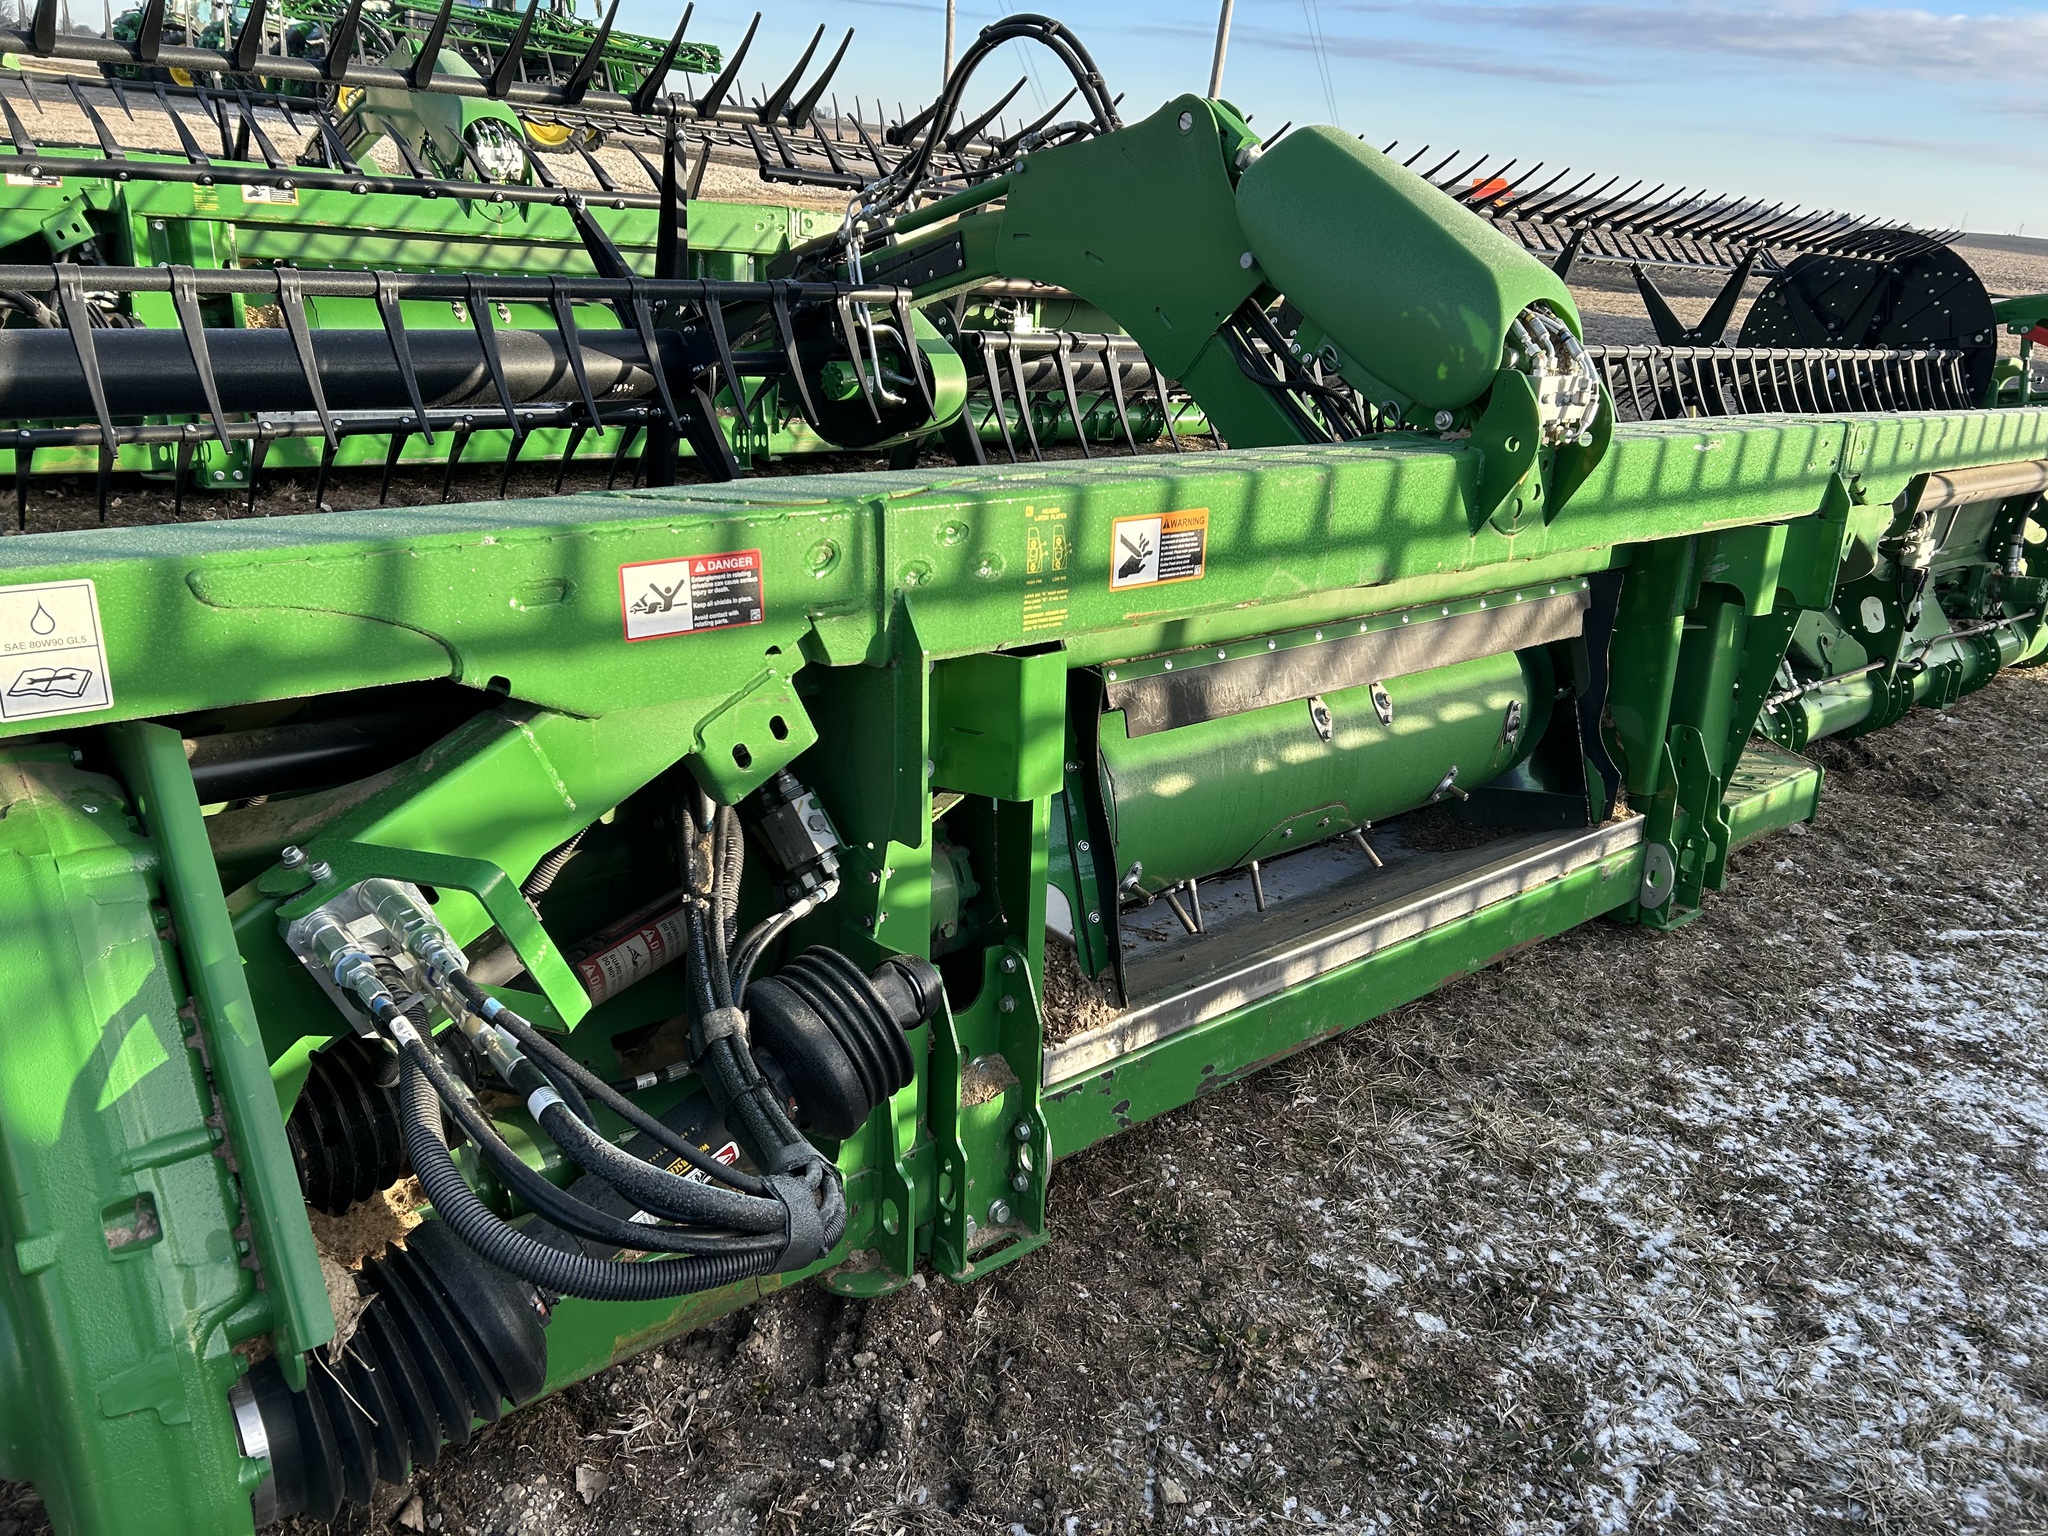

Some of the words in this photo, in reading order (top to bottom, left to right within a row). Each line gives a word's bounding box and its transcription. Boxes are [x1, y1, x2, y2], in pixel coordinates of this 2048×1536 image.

[1171, 516, 1205, 528] WARNING
[708, 556, 753, 571] DANGER
[691, 573, 726, 583] Entanglement
[4, 642, 26, 652] SAE
[29, 638, 64, 649] 80W90
[66, 636, 87, 645] GL5
[661, 923, 668, 932] DO
[602, 956, 609, 966] DO
